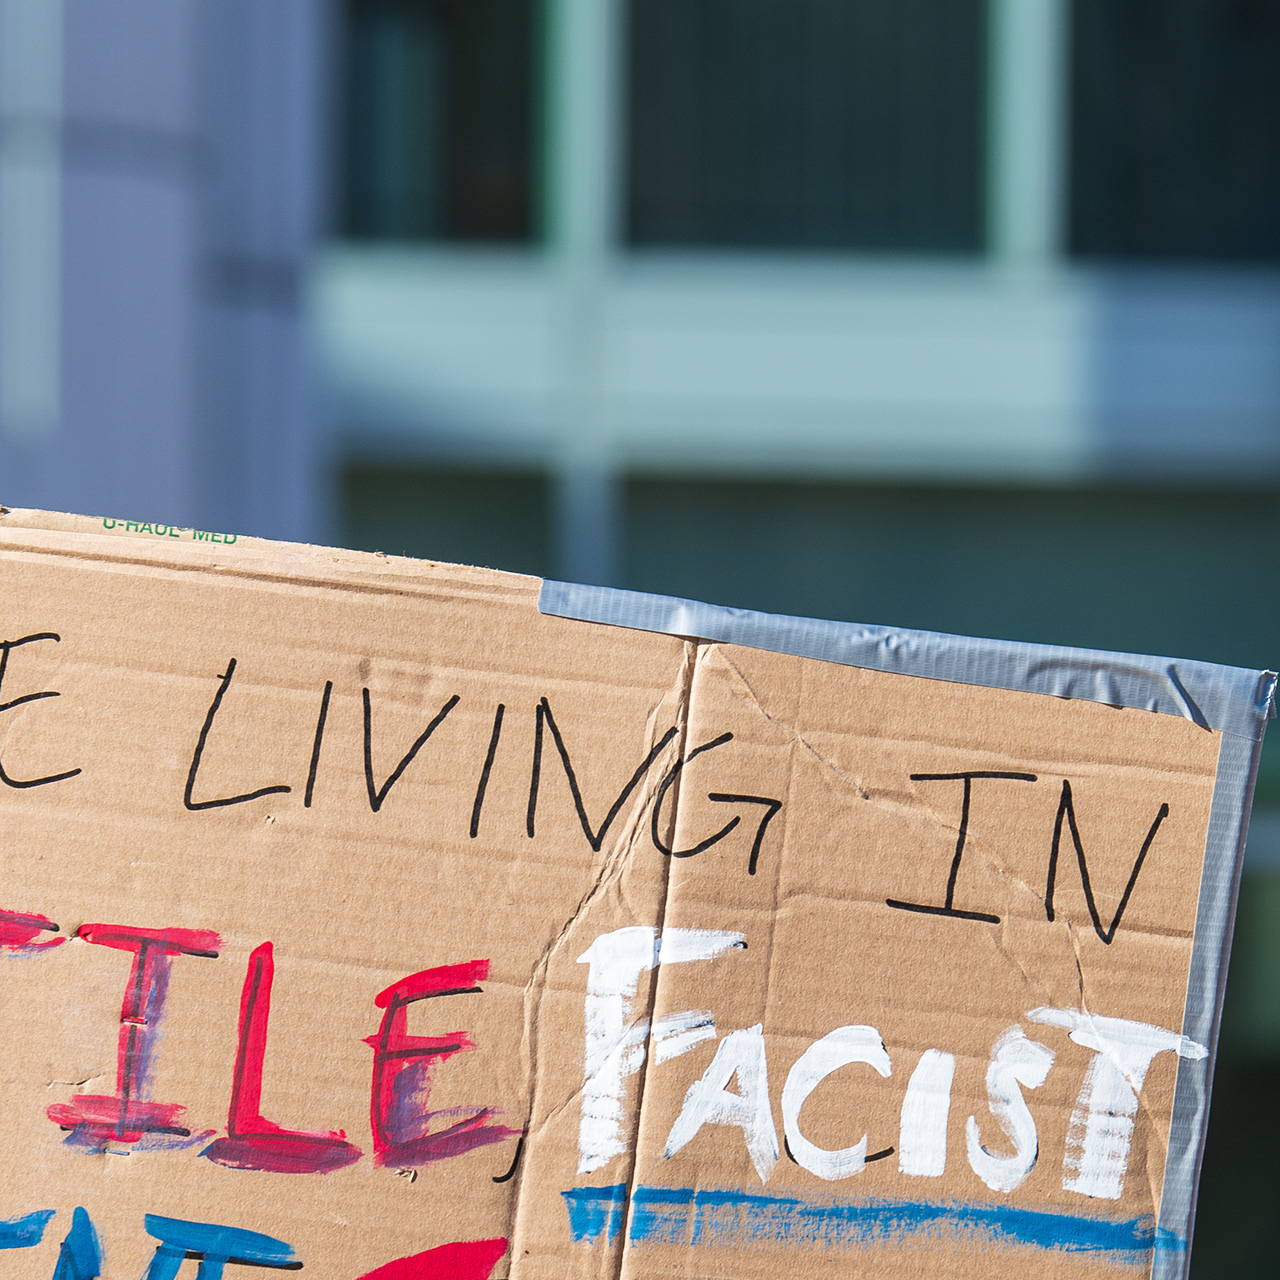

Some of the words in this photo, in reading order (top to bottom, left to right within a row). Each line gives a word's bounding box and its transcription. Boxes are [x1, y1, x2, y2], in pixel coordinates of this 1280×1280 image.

[192, 529, 238, 546] MED
[182, 657, 783, 875] LIVING
[885, 769, 1170, 945] IN
[575, 924, 1210, 1200] FACIST
